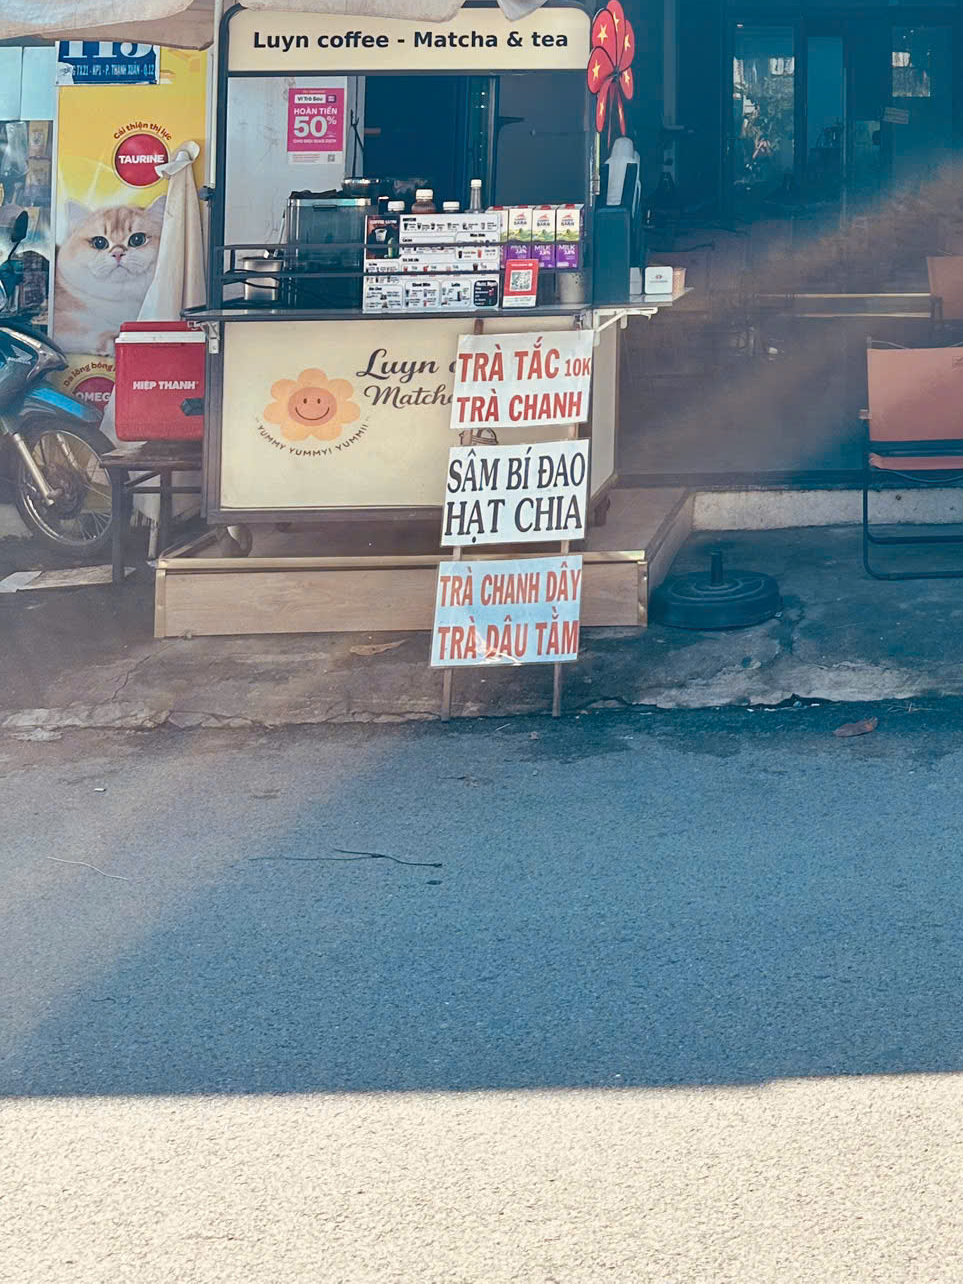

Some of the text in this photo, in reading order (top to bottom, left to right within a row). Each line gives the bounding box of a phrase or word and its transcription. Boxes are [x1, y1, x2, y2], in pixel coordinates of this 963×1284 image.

[253, 31, 309, 52] Luyn
[317, 31, 390, 48] coffee
[414, 31, 498, 48] Matcha
[506, 31, 523, 48] &
[532, 32, 568, 48] tea
[294, 106, 317, 115] HOÀN
[294, 115, 337, 138] 50%
[118, 154, 165, 164] TAURINE
[356, 348, 440, 384] Luyn
[458, 336, 592, 383] TRÀ TẮC 10K
[74, 392, 111, 402] OMEG
[132, 380, 197, 391] HIỆP THANH
[457, 389, 583, 423] TRÀ CHANH
[257, 425, 287, 450] YUMMY
[447, 446, 586, 493] SÂM BÍ ĐAO
[444, 494, 583, 544] HẠT CHIA
[440, 561, 582, 607] TRÀ CHANH DÂY
[437, 605, 579, 660] TRÀ DÂU TẰM
